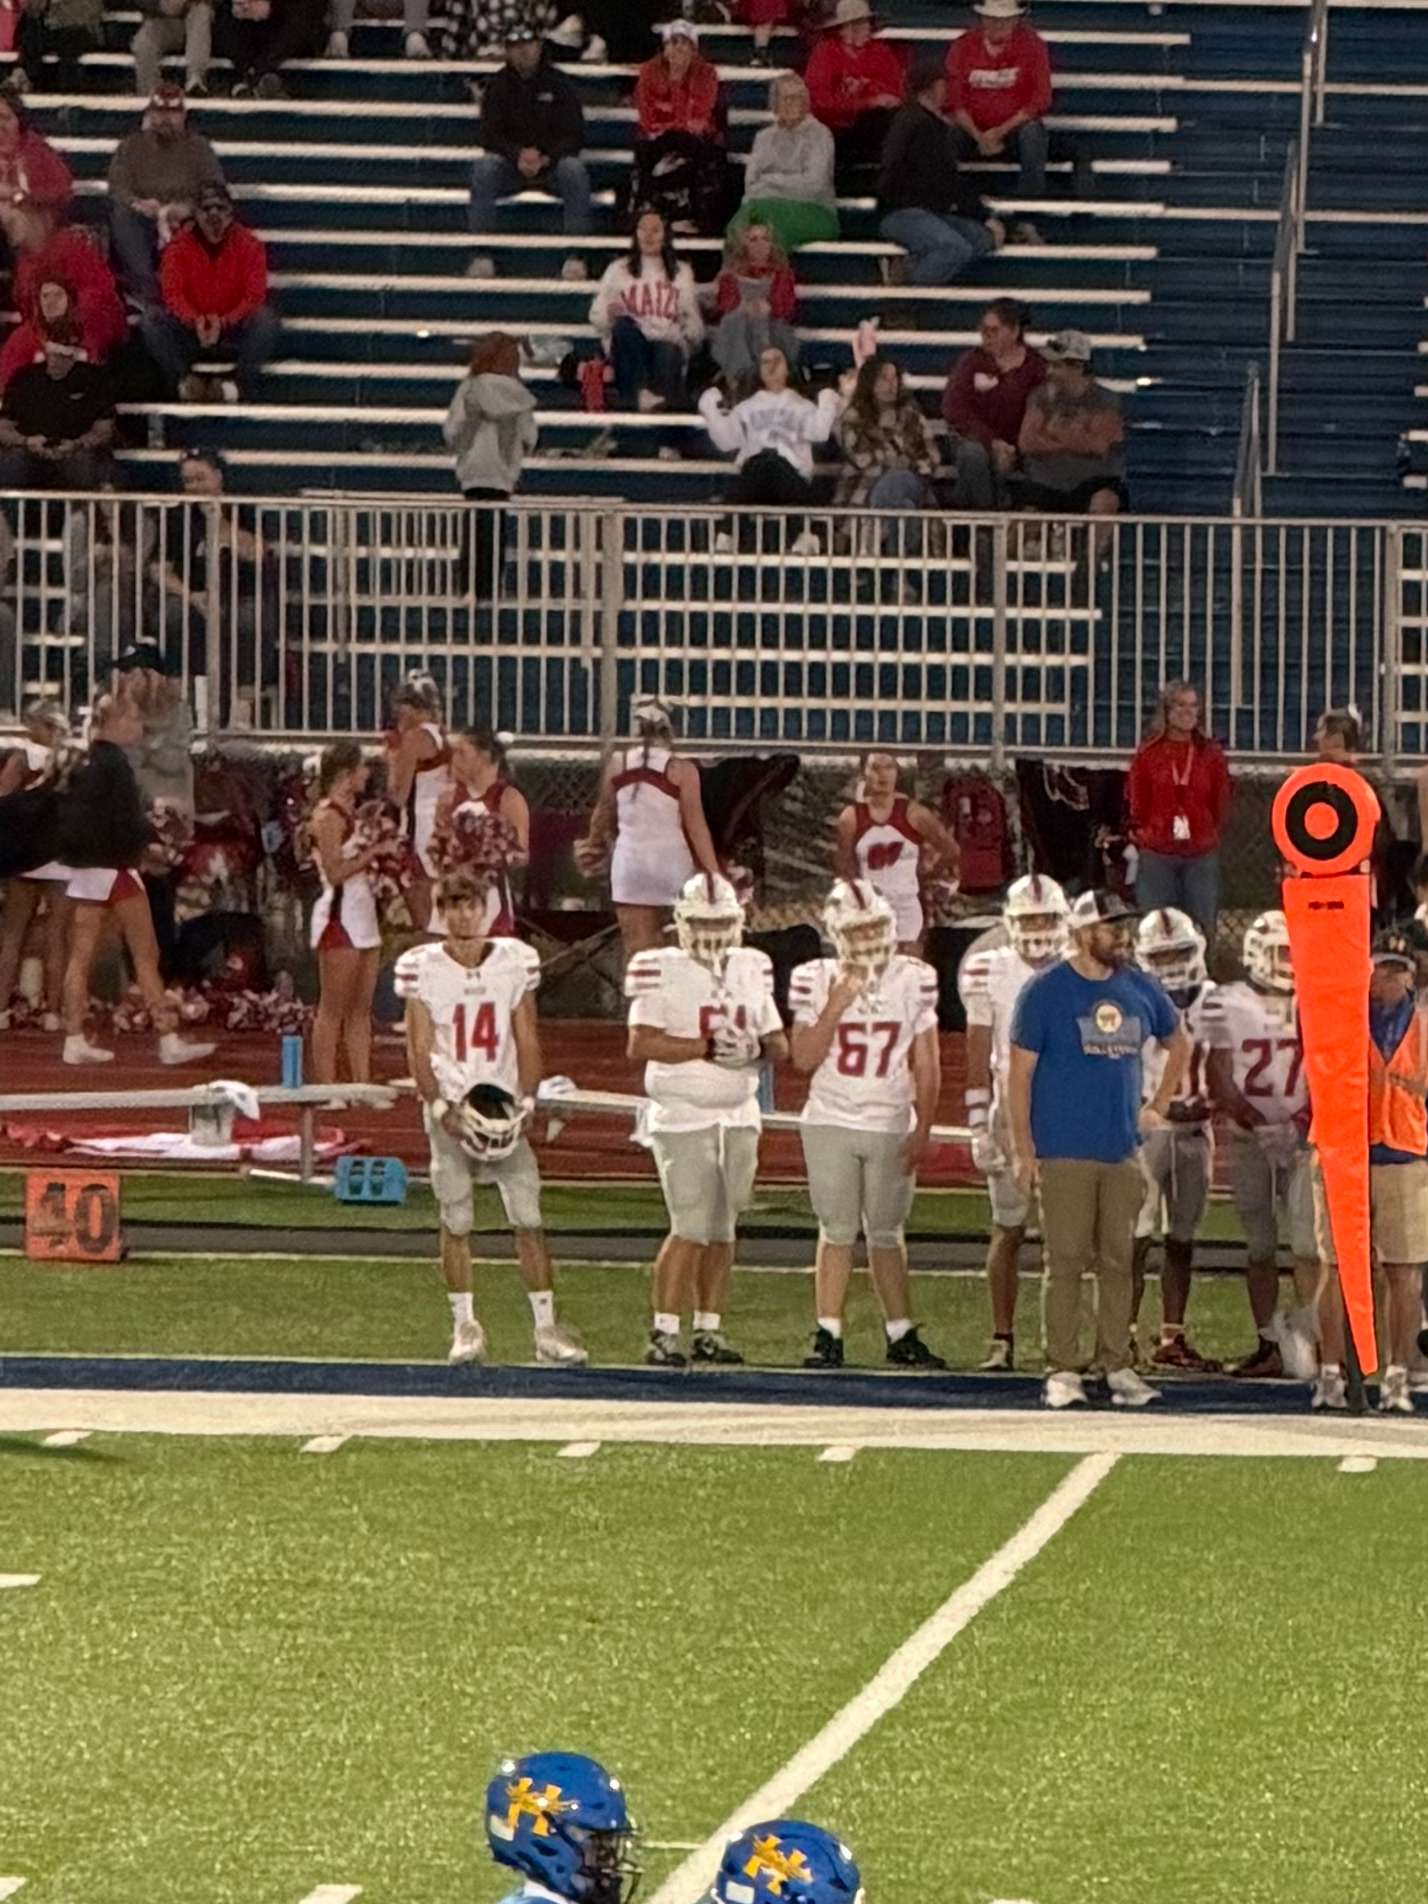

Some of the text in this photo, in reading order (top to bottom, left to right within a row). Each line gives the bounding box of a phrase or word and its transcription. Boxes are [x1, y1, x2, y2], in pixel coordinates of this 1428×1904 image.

[453, 1003, 499, 1062] 14
[837, 1021, 902, 1078] 67
[1241, 1038, 1304, 1098] 27
